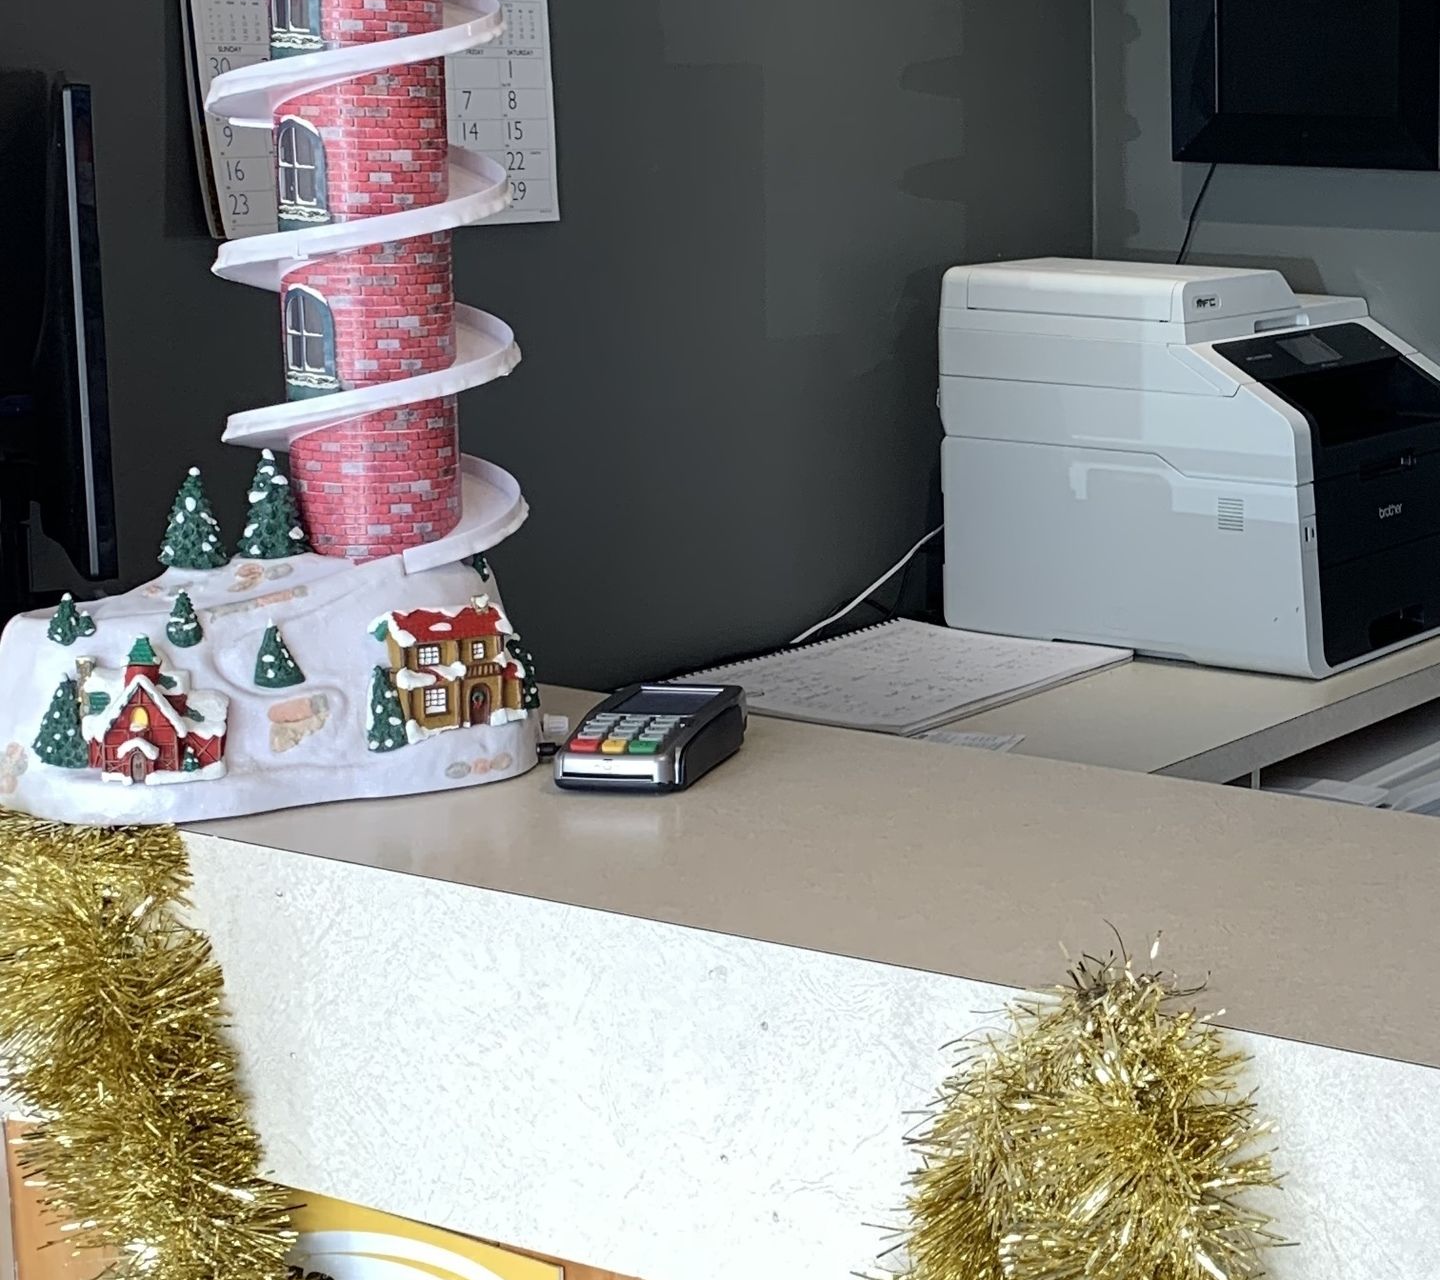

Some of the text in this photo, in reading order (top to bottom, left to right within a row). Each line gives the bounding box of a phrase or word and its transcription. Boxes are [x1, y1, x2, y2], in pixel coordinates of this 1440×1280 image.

[462, 90, 517, 110] 7 8
[223, 126, 233, 147] 9
[462, 121, 523, 141] 14 15
[226, 160, 245, 181] 16
[506, 151, 525, 170] 22
[229, 193, 249, 215] 23
[1378, 503, 1402, 519] brother
